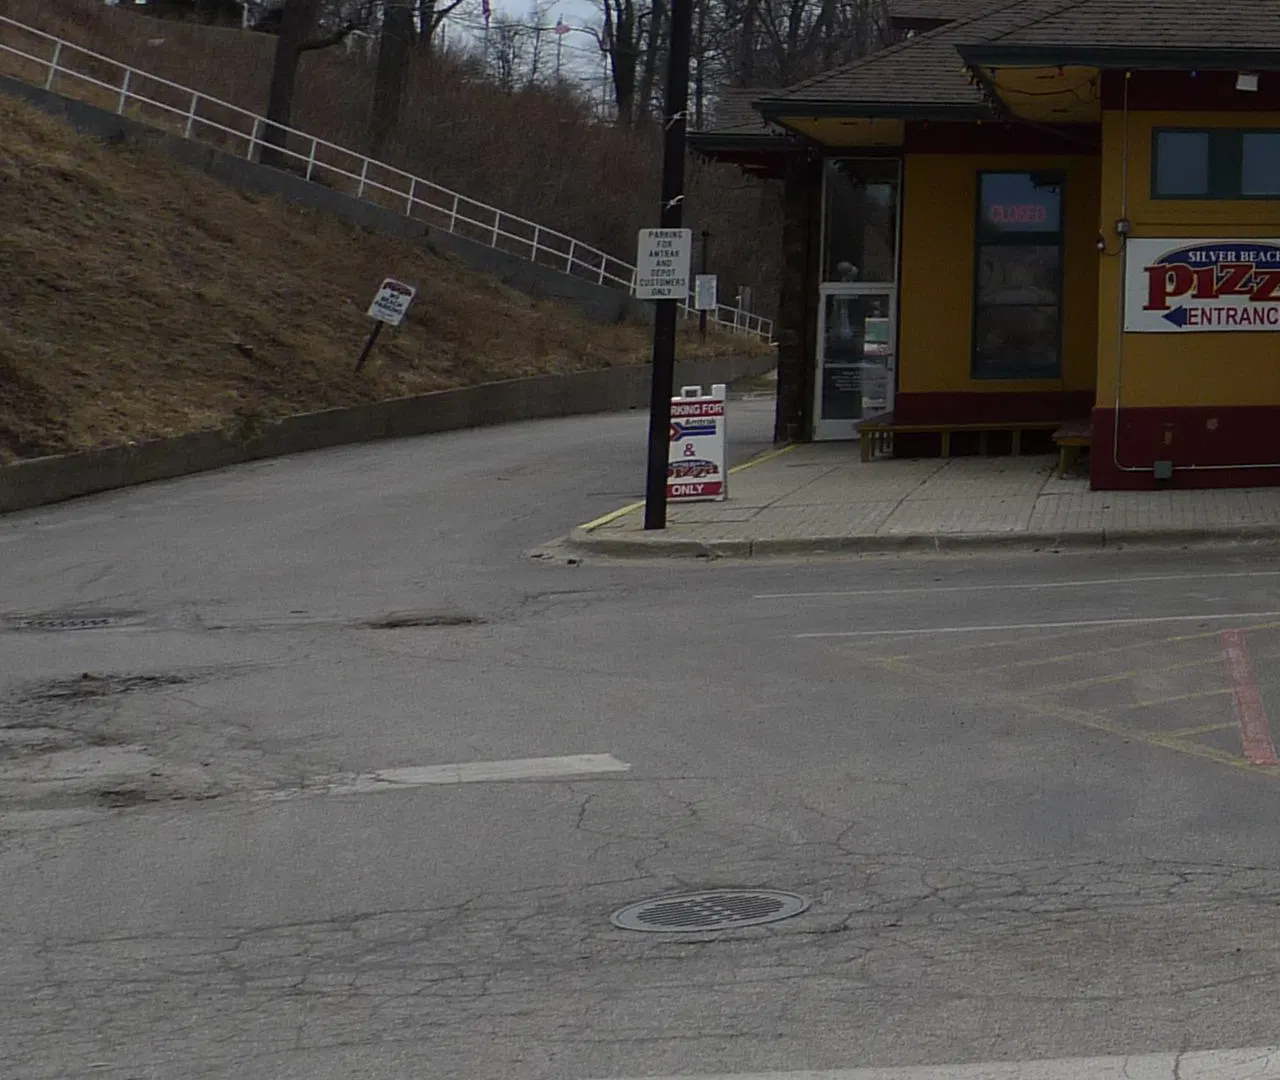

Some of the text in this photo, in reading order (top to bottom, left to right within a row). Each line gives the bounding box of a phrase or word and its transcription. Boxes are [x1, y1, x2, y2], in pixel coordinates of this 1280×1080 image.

[648, 231, 683, 239] PARKING
[1188, 250, 1237, 262] SILVER
[671, 403, 722, 415] RKING FOR
[683, 443, 696, 457] &
[671, 484, 705, 496] ONLY
